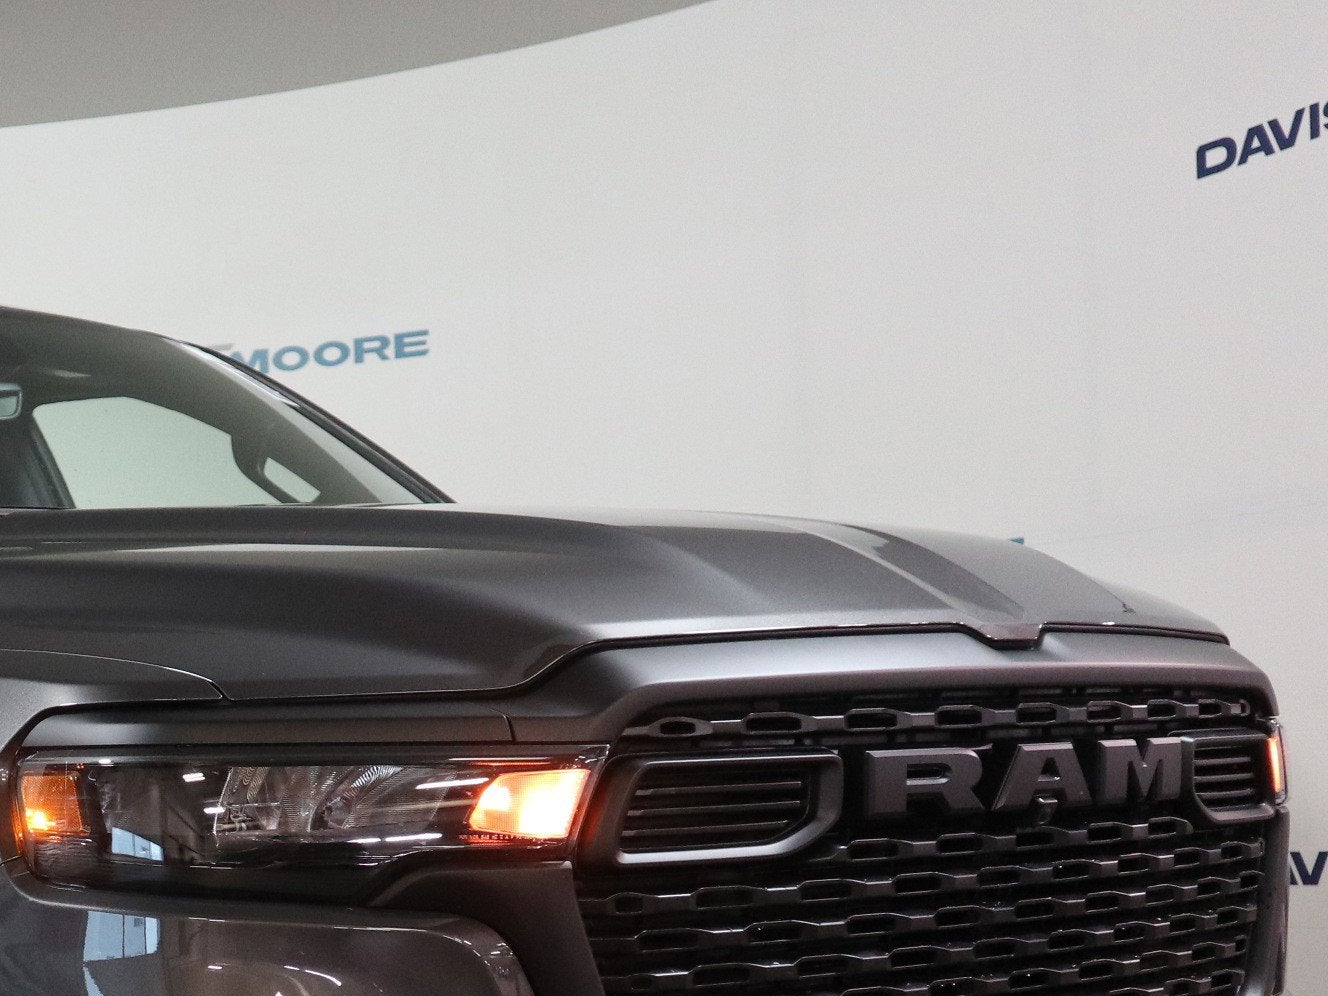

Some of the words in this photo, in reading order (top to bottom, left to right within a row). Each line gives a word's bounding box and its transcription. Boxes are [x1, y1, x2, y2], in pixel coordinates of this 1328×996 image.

[1195, 100, 1328, 179] DAVI
[227, 329, 430, 374] MOORE
[865, 737, 1182, 815] RAM
